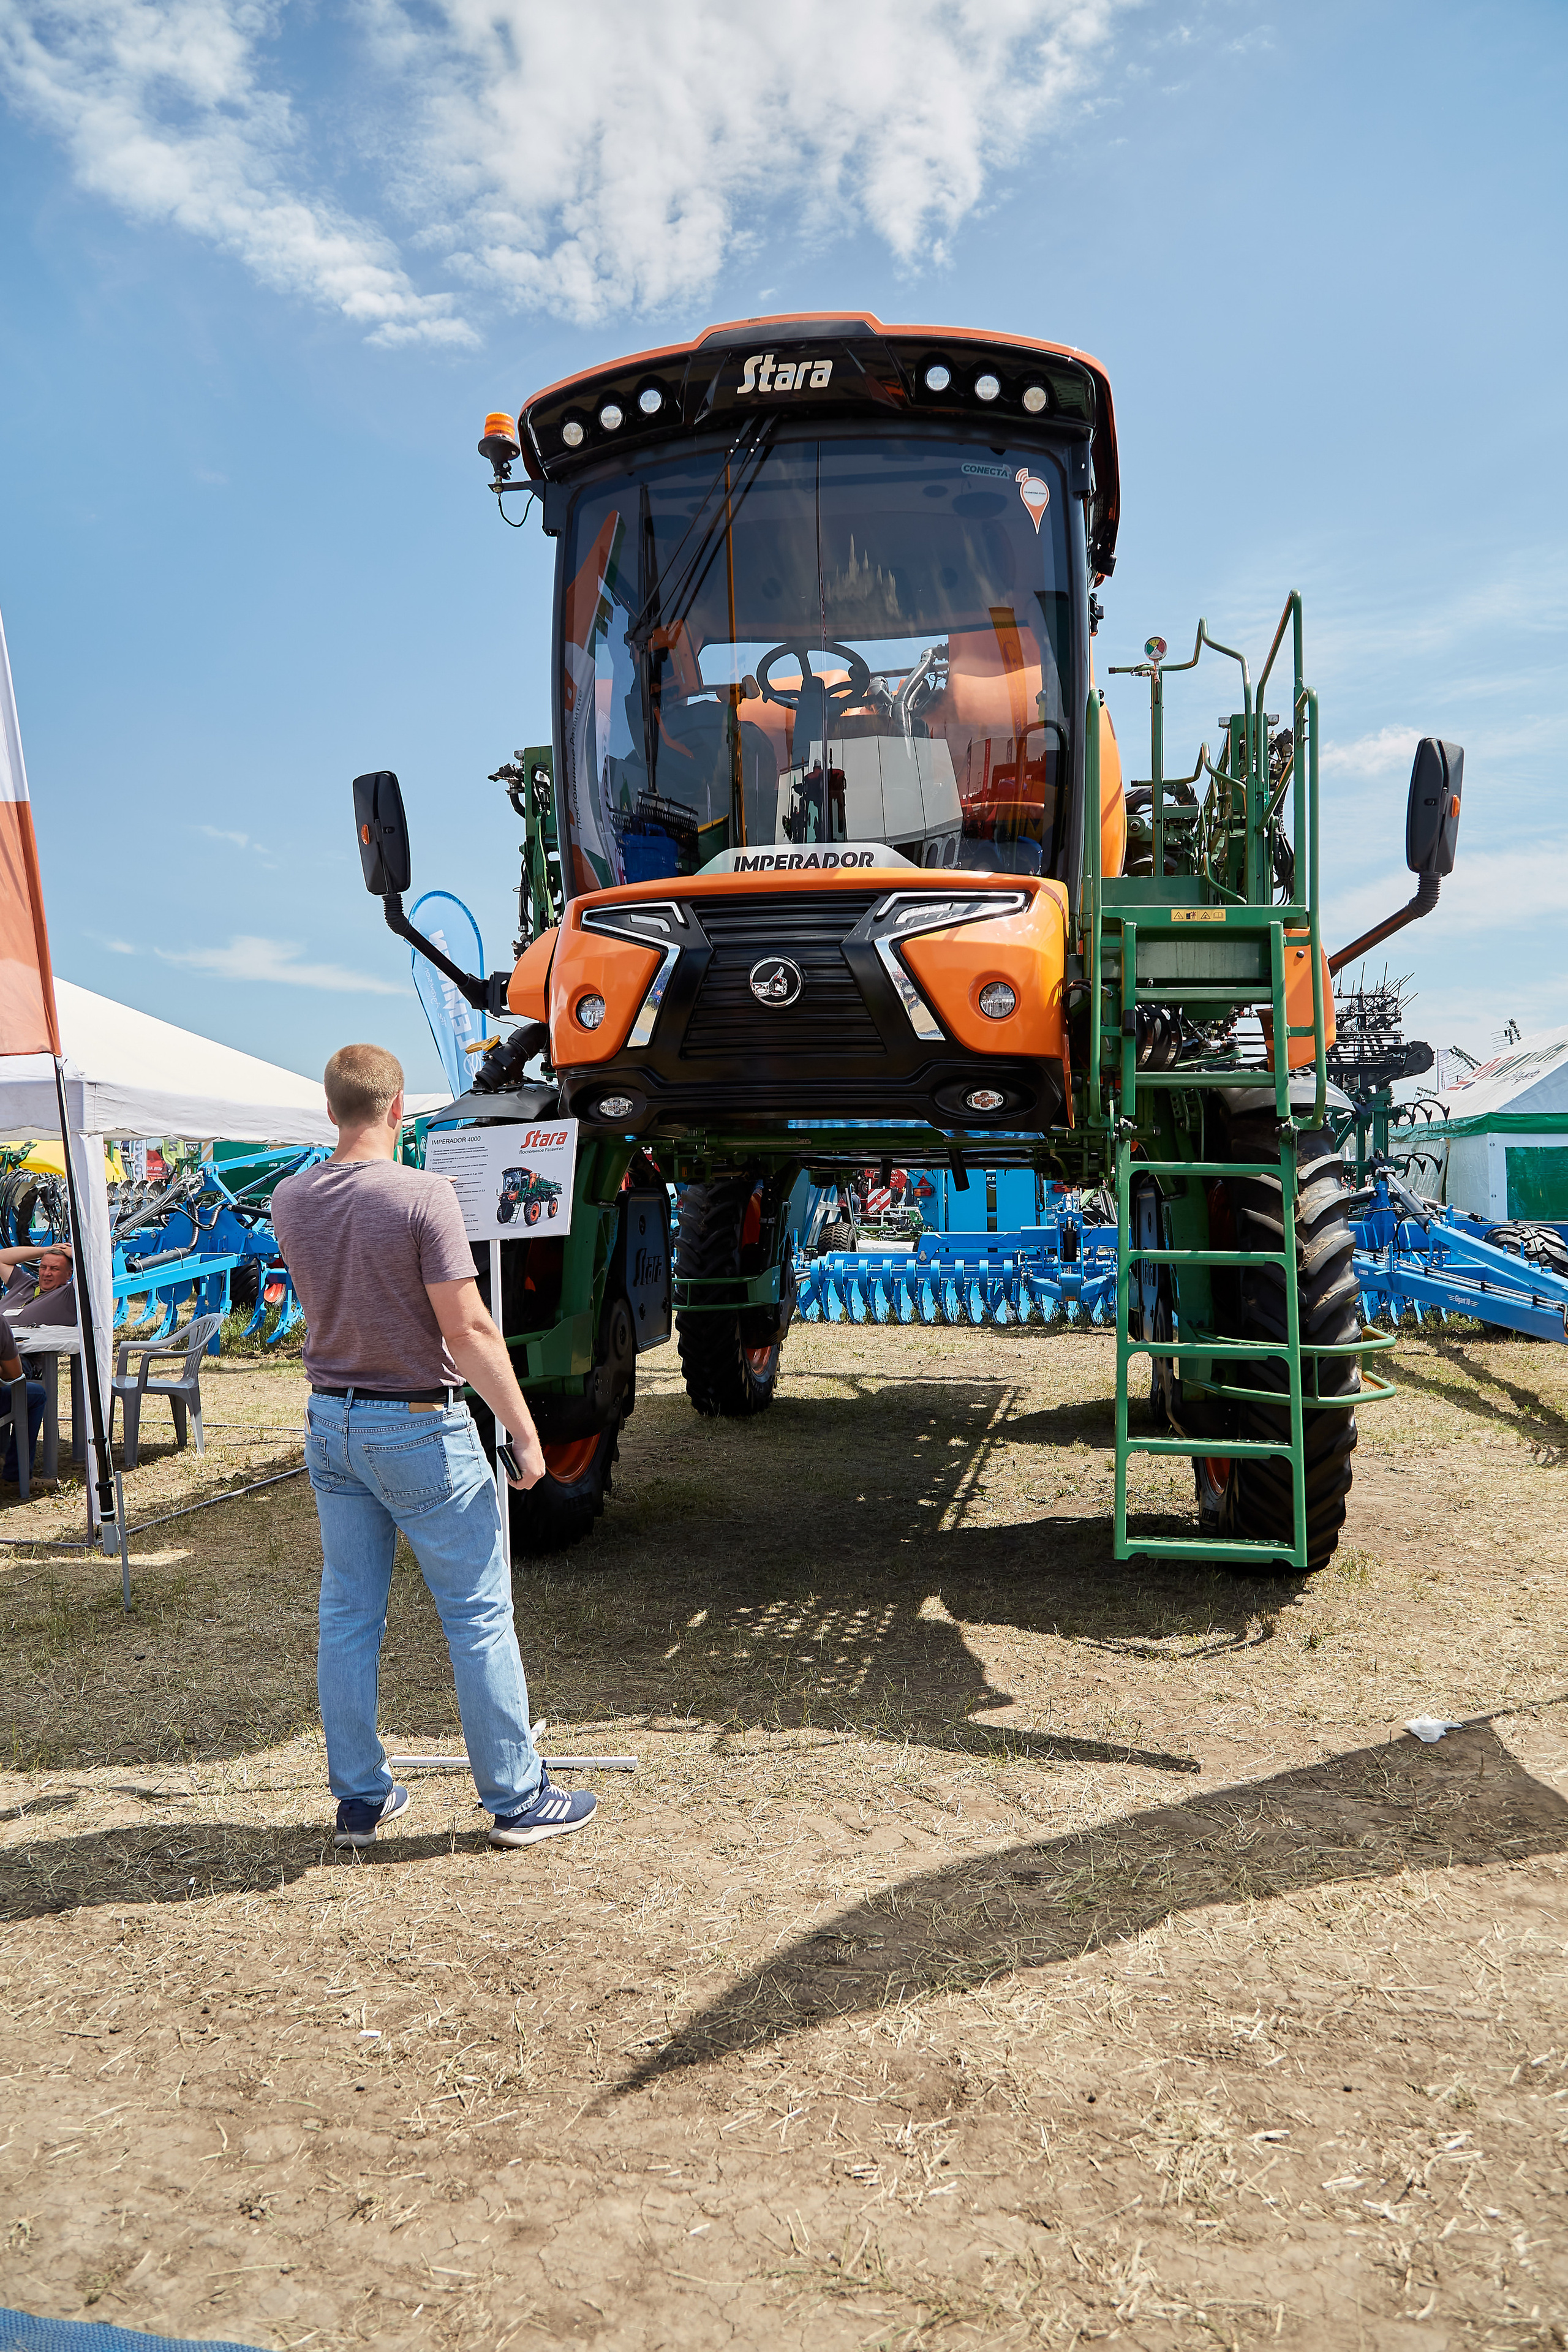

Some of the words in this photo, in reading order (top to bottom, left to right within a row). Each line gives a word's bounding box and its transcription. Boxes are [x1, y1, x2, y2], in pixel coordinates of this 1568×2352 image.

[737, 354, 833, 394] Stara
[963, 464, 1008, 477] CONECTA
[733, 851, 875, 872] IMPERADOR
[431, 1137, 467, 1145] IMPERADOR
[520, 1129, 568, 1149] Stara
[1455, 1294, 1466, 1305] Gigant
